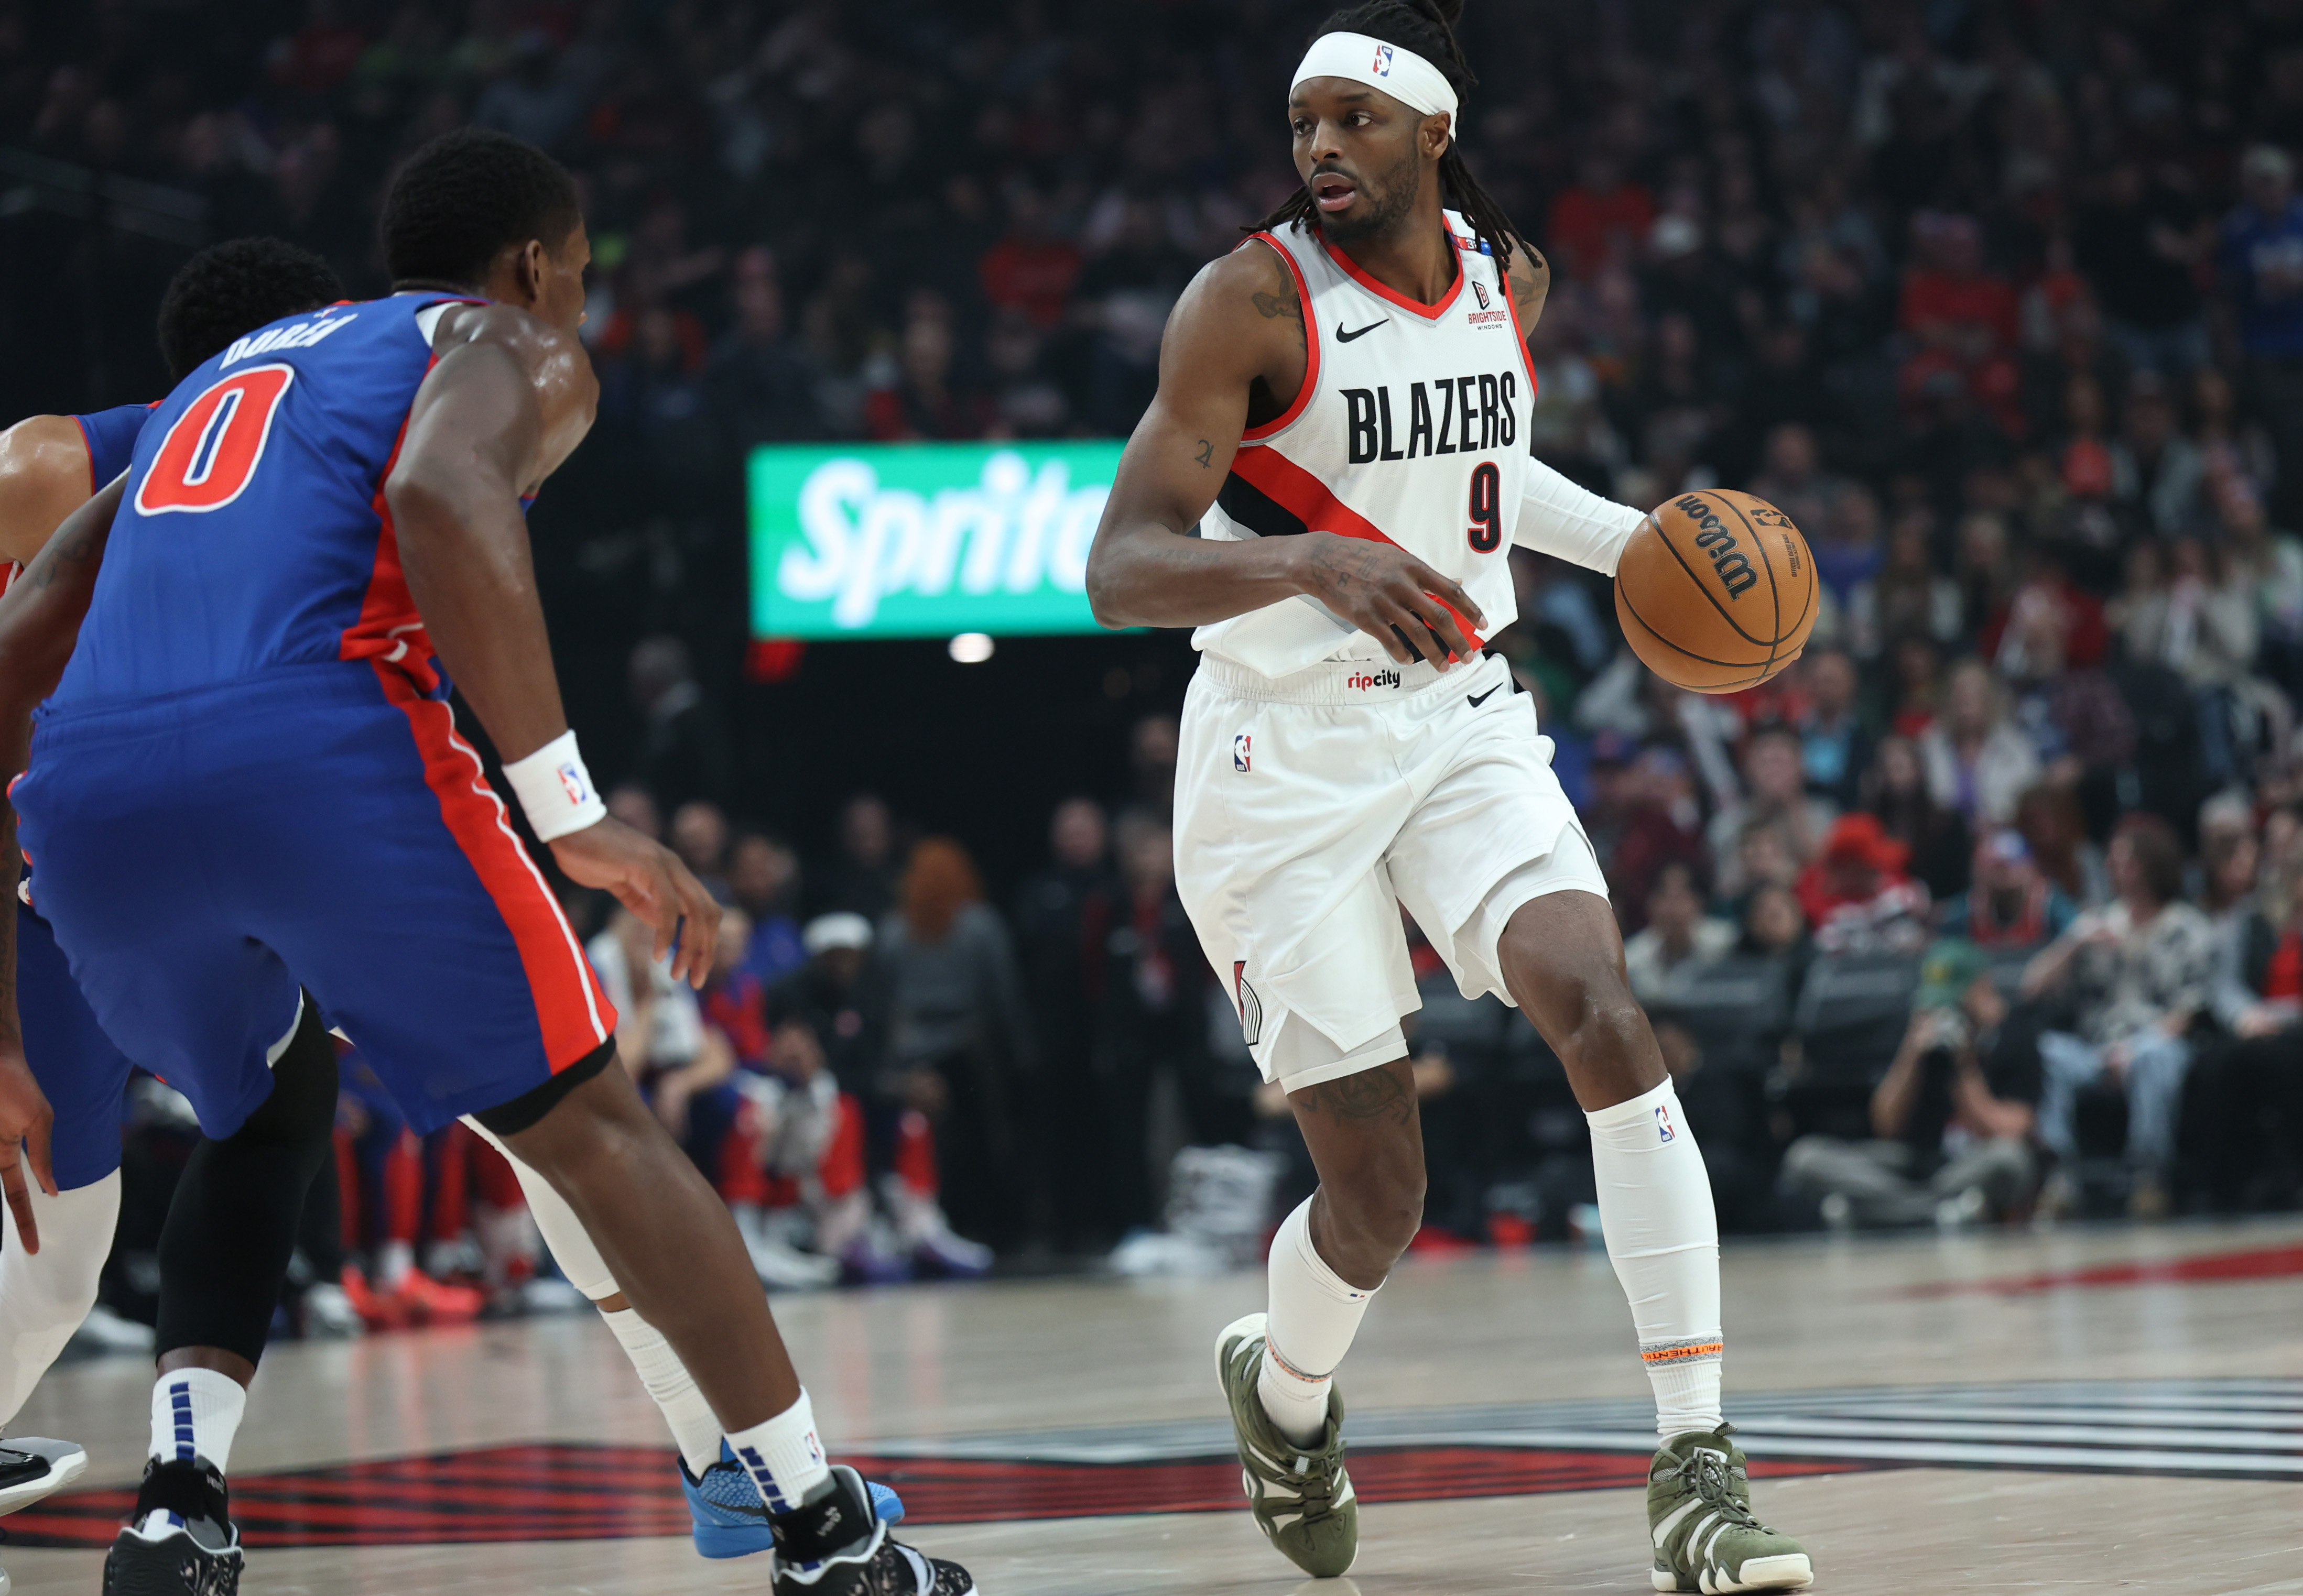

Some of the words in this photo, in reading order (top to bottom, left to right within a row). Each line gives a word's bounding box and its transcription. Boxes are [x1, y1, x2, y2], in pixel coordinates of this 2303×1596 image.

[1468, 311, 1507, 324] BRIGHTSIDE
[1478, 286, 1487, 304] B
[134, 363, 295, 517] 0
[1338, 371, 1516, 464] BLAZERS
[1468, 462, 1502, 554] 9
[1674, 495, 1758, 602] Wilson
[1348, 669, 1400, 692] ripcity
[1641, 1346, 1717, 1360] AUTHENTIC
